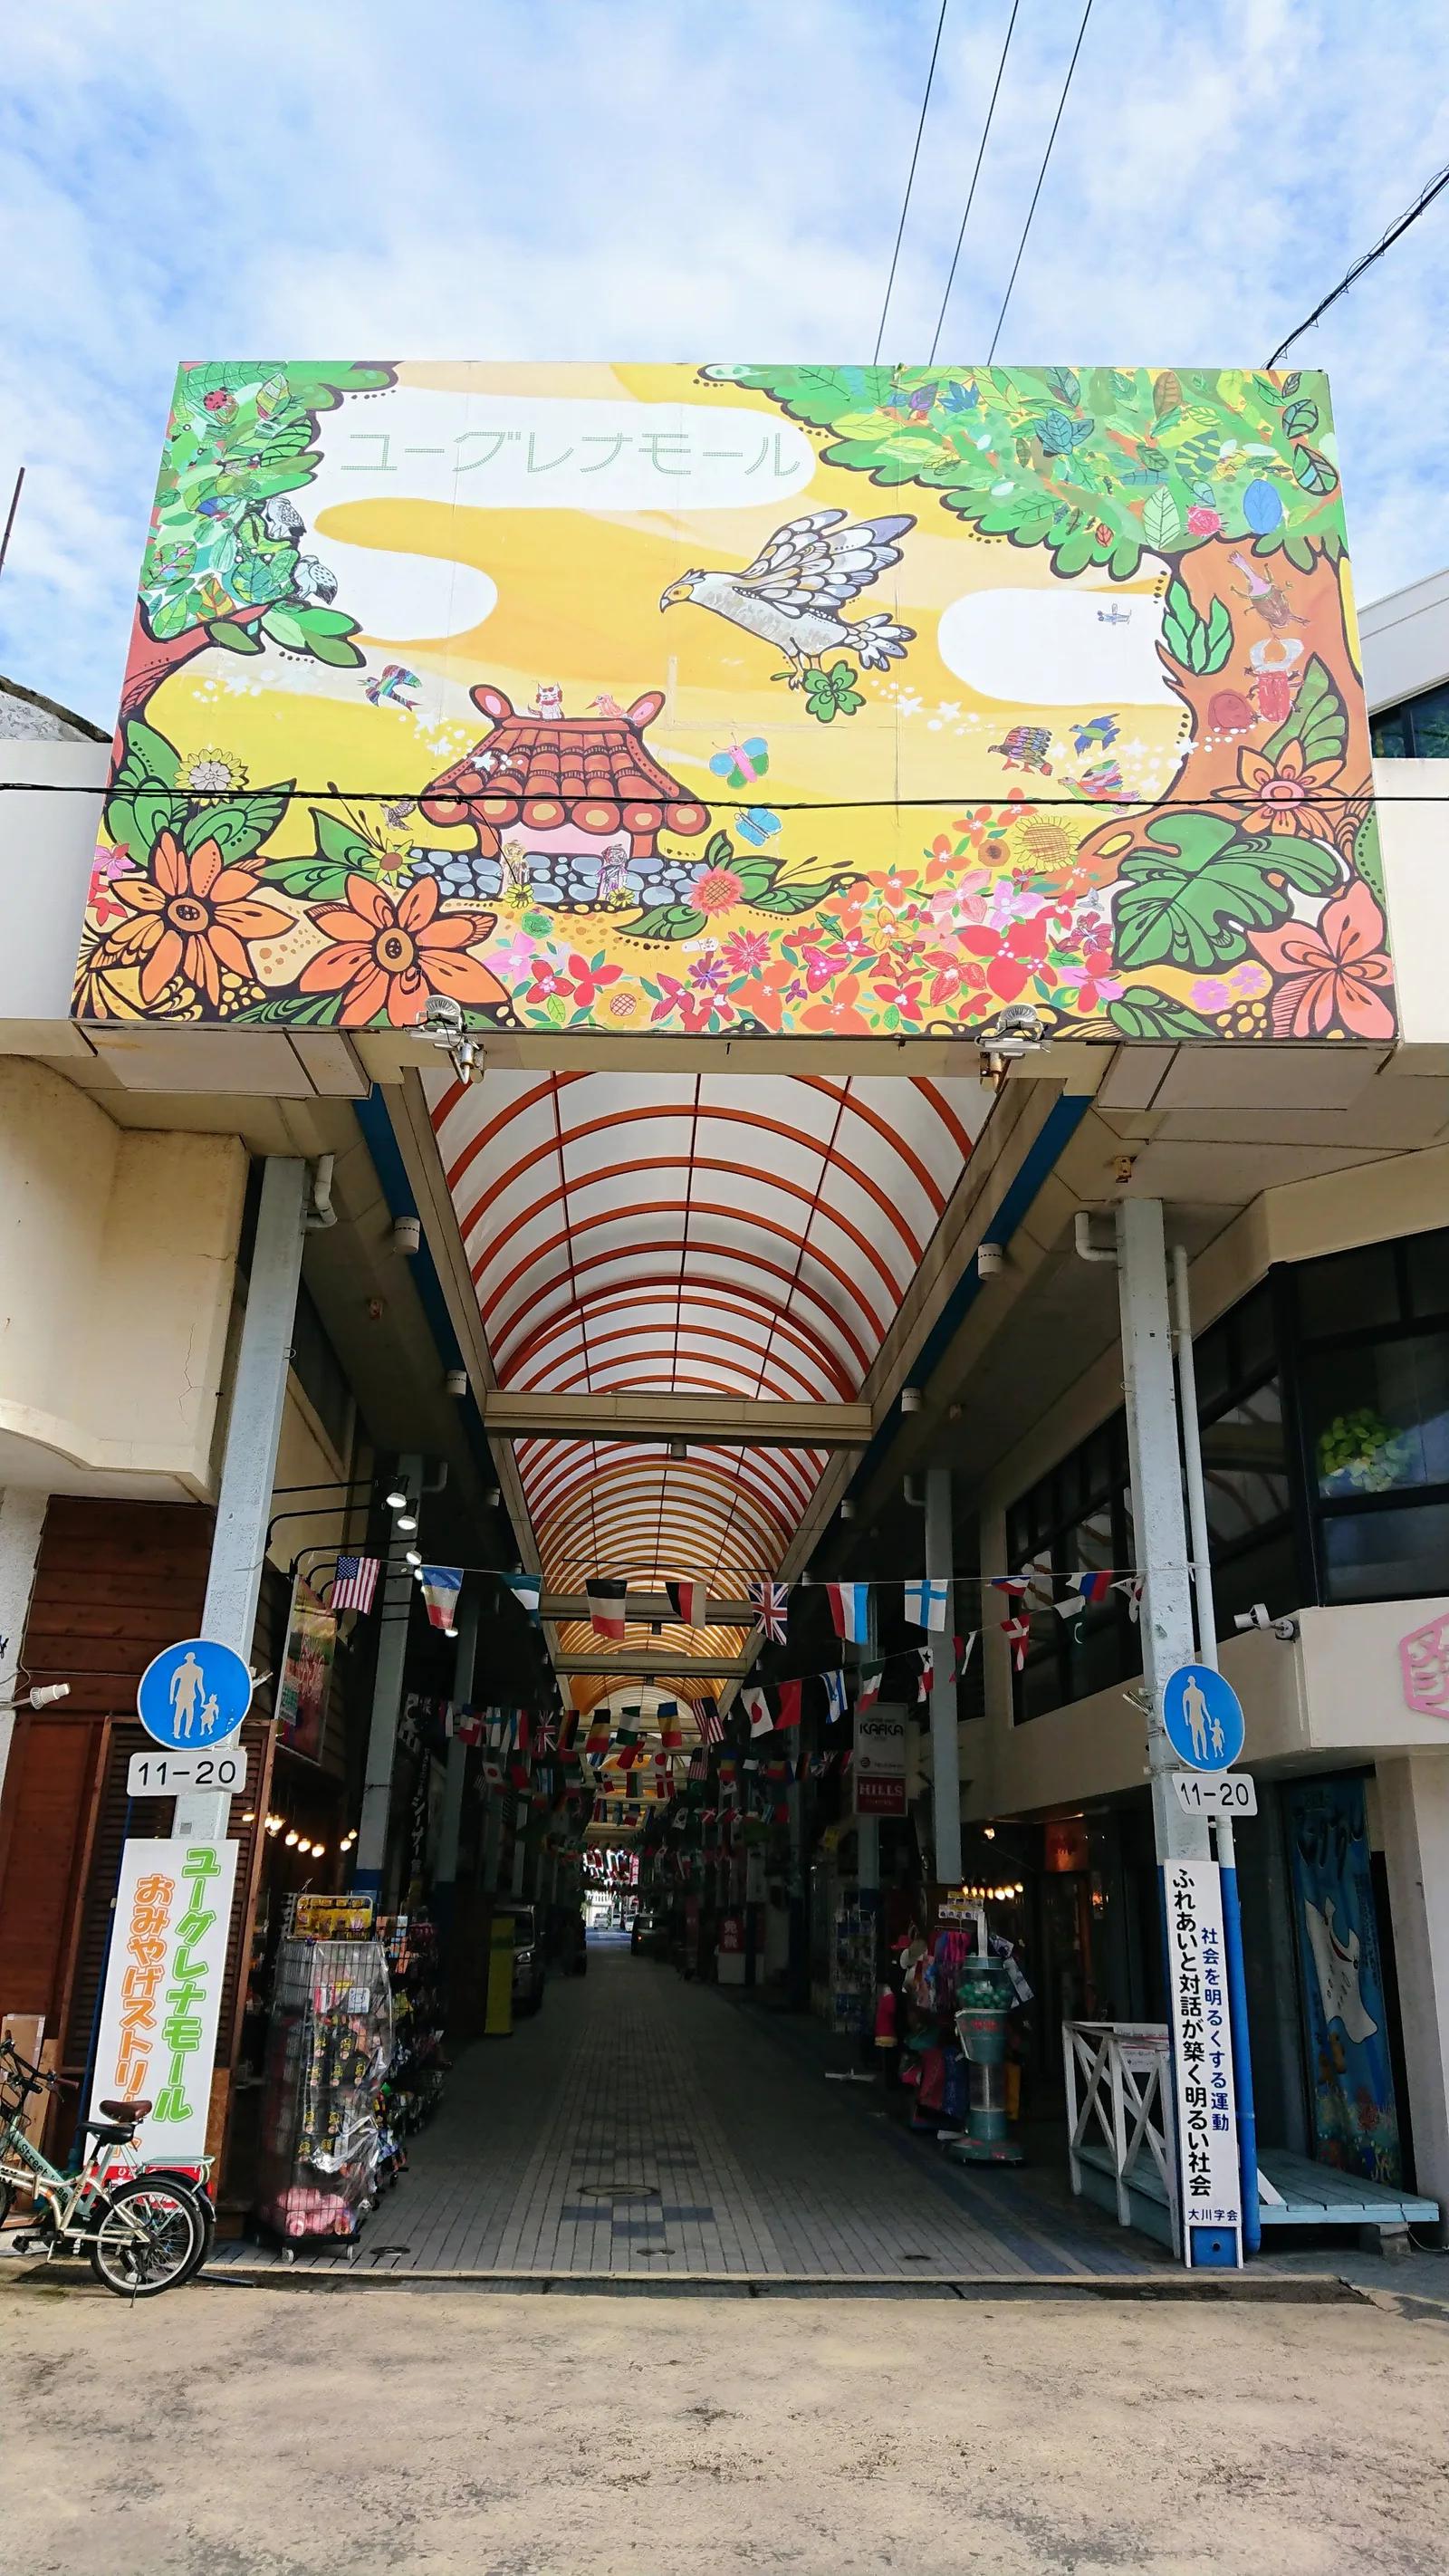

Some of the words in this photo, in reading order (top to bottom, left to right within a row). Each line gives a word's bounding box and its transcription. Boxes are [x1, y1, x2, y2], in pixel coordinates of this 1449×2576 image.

[341, 430, 801, 477] ユーグレナモール
[859, 1723, 904, 1736] KAFKA
[138, 1760, 236, 1786] 11-20
[859, 1782, 903, 1798] HILLS
[1180, 1782, 1250, 1806] 11-20
[152, 1847, 222, 2123] ユーグレナモール
[112, 1873, 176, 2158] おみやげストリ
[1172, 1868, 1212, 2197] ふれあいと対話が築く明るい社会
[1201, 1927, 1230, 2132] 社会を明るくする運動
[19, 2143, 48, 2177] Street
[1187, 2208, 1239, 2222] 大川字会
